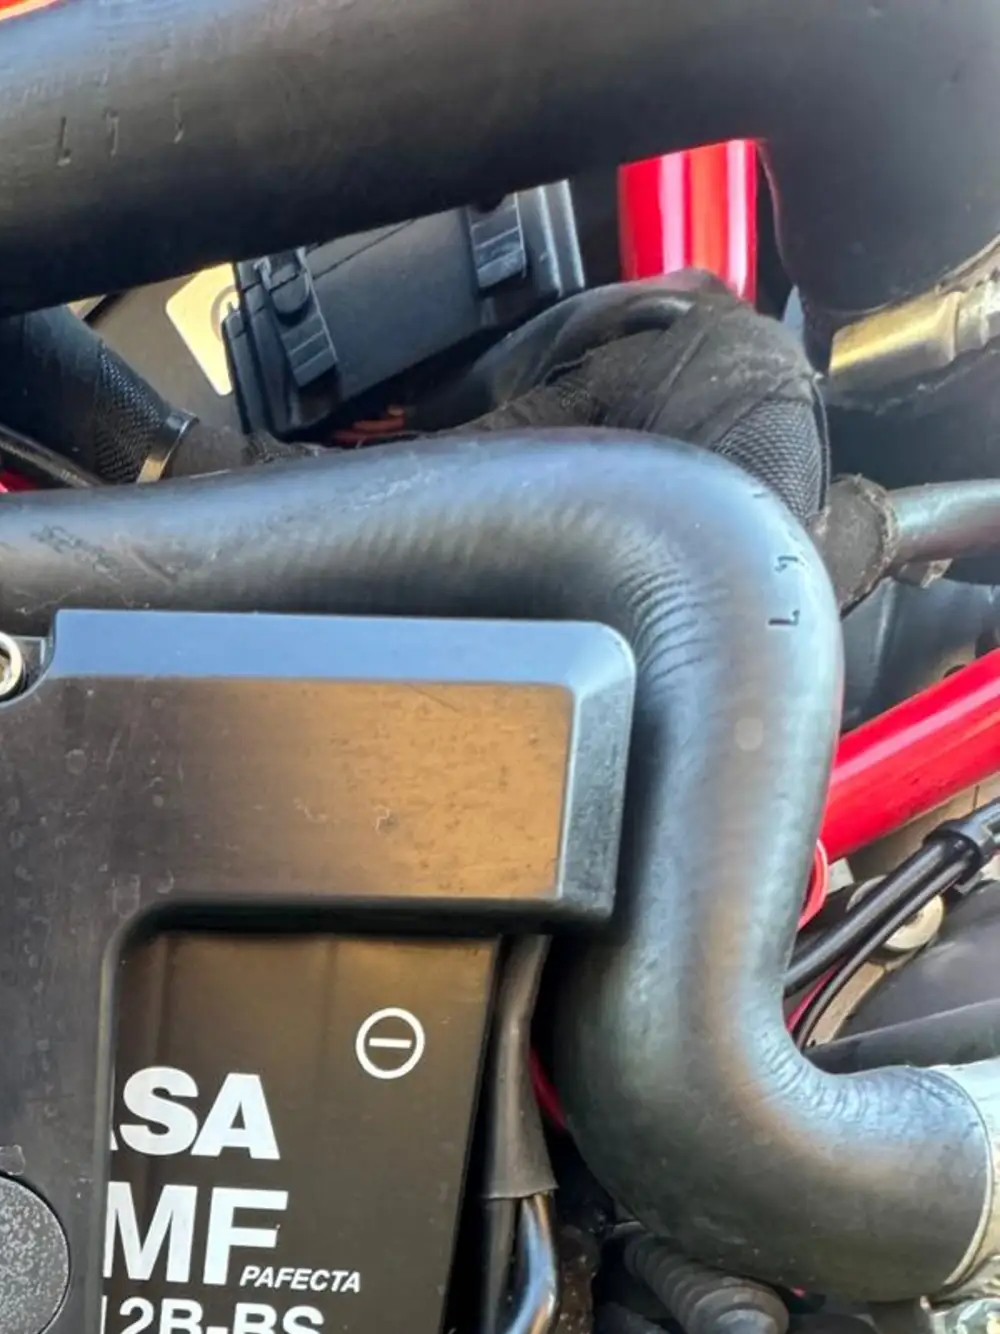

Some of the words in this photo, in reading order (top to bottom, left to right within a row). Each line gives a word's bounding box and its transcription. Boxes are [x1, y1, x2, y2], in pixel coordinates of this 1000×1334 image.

[109, 1066, 281, 1161] SA
[102, 1181, 289, 1286] MF
[239, 1265, 361, 1293] PAFECTA
